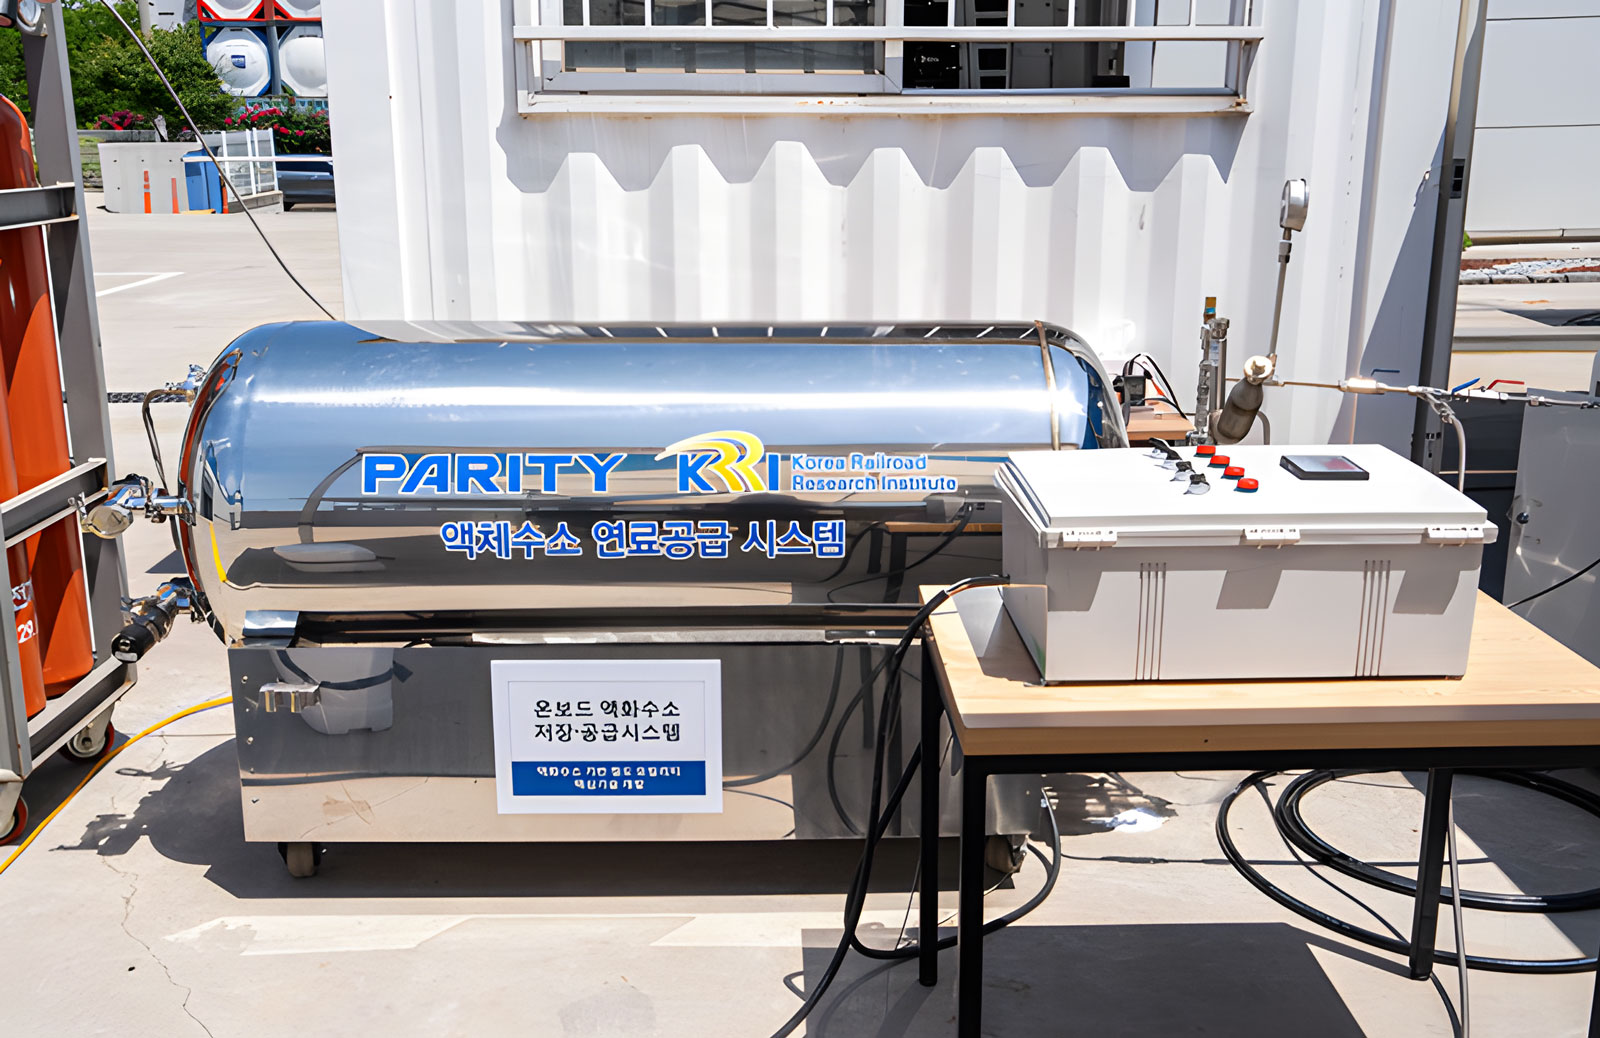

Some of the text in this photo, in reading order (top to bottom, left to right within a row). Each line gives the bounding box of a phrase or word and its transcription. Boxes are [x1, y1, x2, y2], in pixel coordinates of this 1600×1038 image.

[362, 453, 627, 494] PARITY
[654, 430, 780, 493] KRRI
[792, 452, 928, 471] Korea Railroad
[792, 474, 958, 492] Research Institute
[440, 519, 846, 559] 액체수소 연료공급 시스템
[534, 700, 593, 718] 온보드
